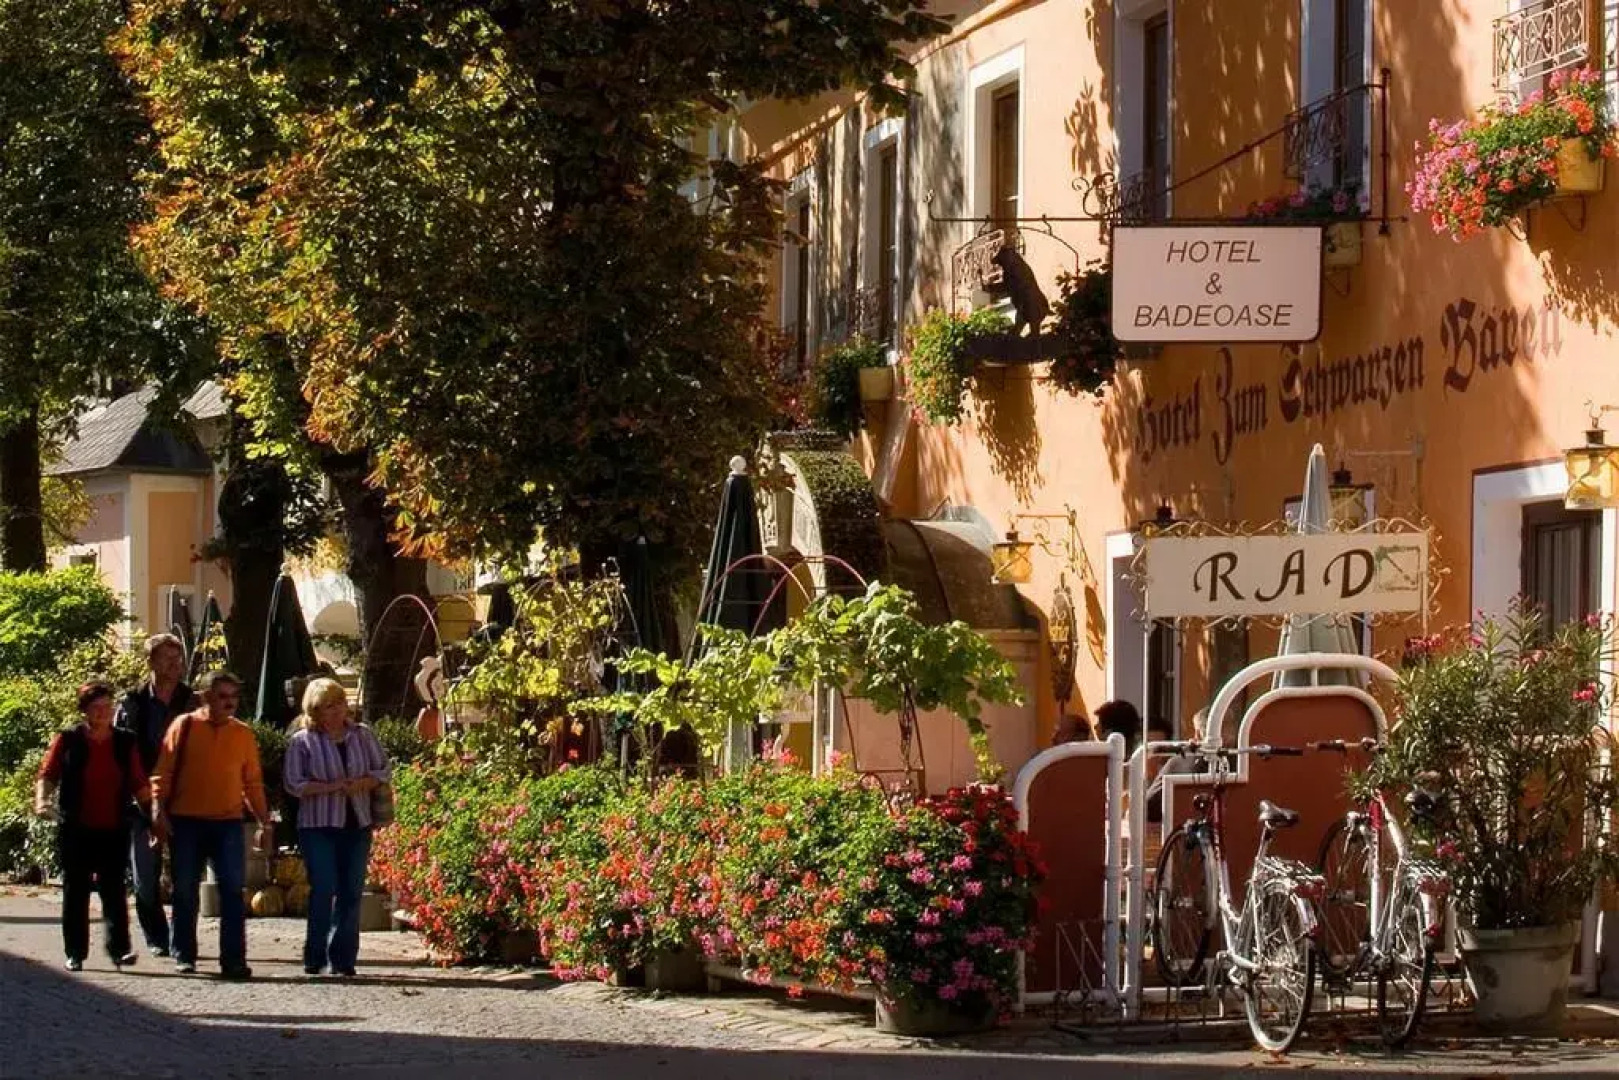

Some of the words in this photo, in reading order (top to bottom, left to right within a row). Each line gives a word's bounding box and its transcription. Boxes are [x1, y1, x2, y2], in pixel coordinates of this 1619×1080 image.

[1166, 240, 1262, 263] HOTEL
[1204, 271, 1223, 295] &
[1133, 304, 1294, 328] BADEOASE
[1278, 336, 1425, 430] Schwarzen
[1440, 296, 1563, 394] Bären
